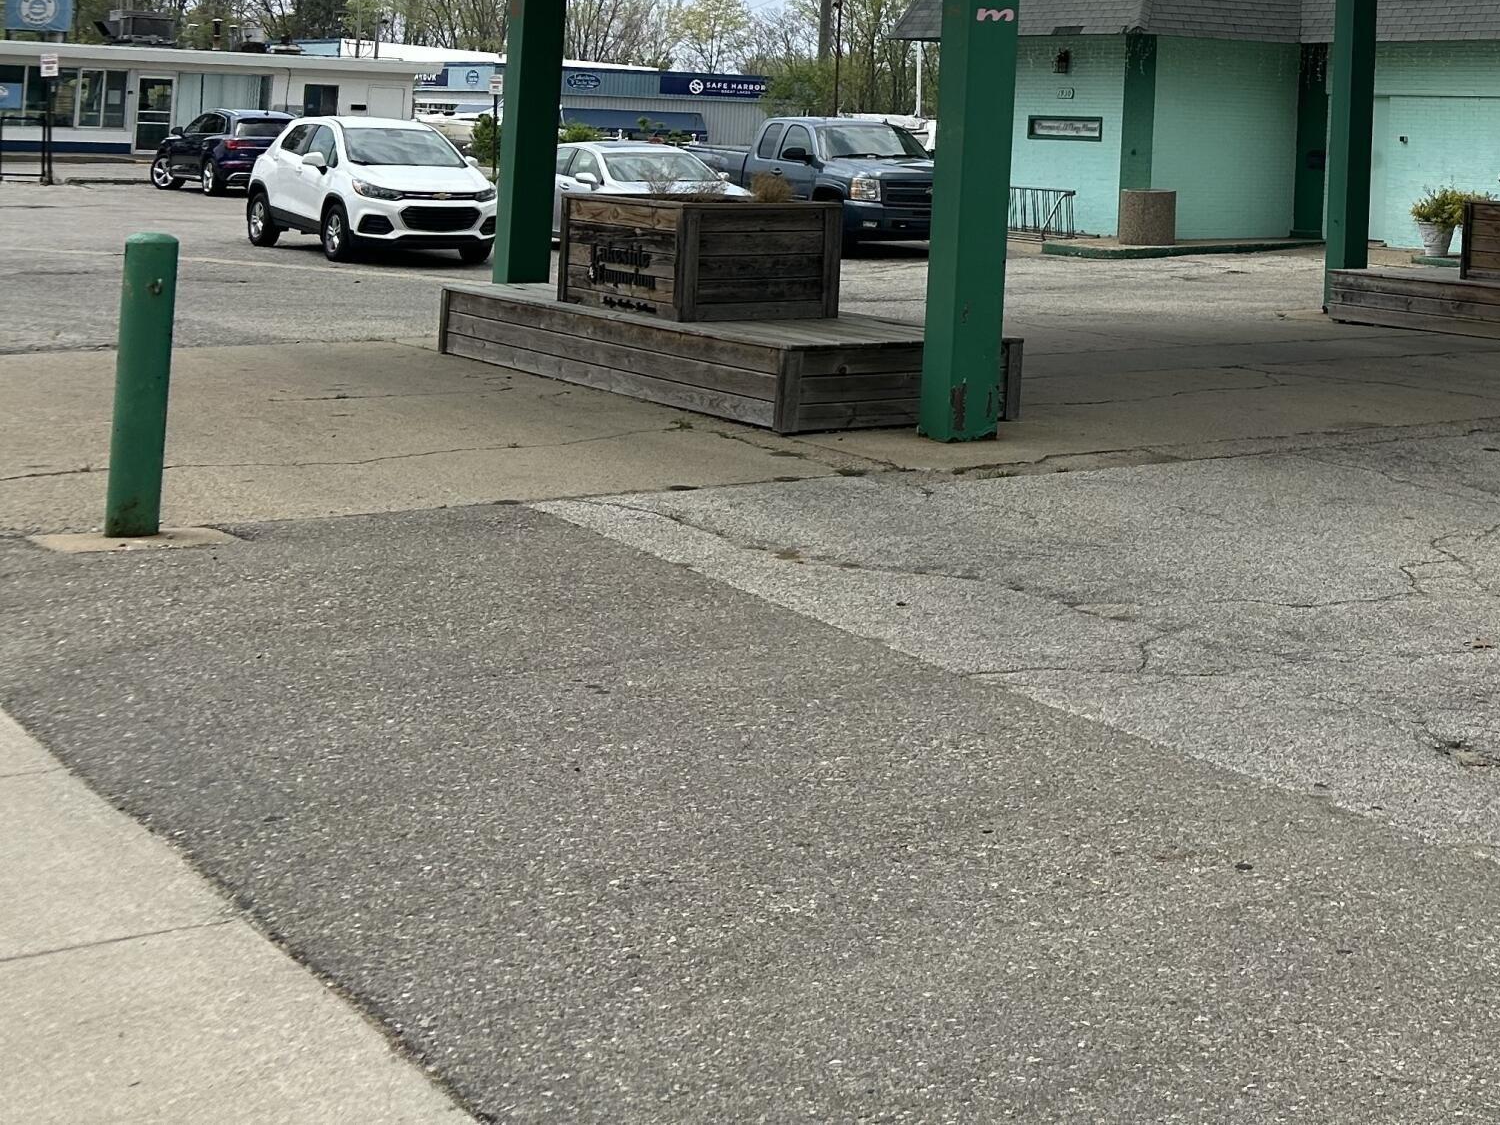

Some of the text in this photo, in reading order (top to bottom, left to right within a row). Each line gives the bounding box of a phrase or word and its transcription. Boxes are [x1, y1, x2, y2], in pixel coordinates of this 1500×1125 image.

[706, 81, 767, 91] SAFE HARBOR
[591, 241, 653, 269] Lakeside
